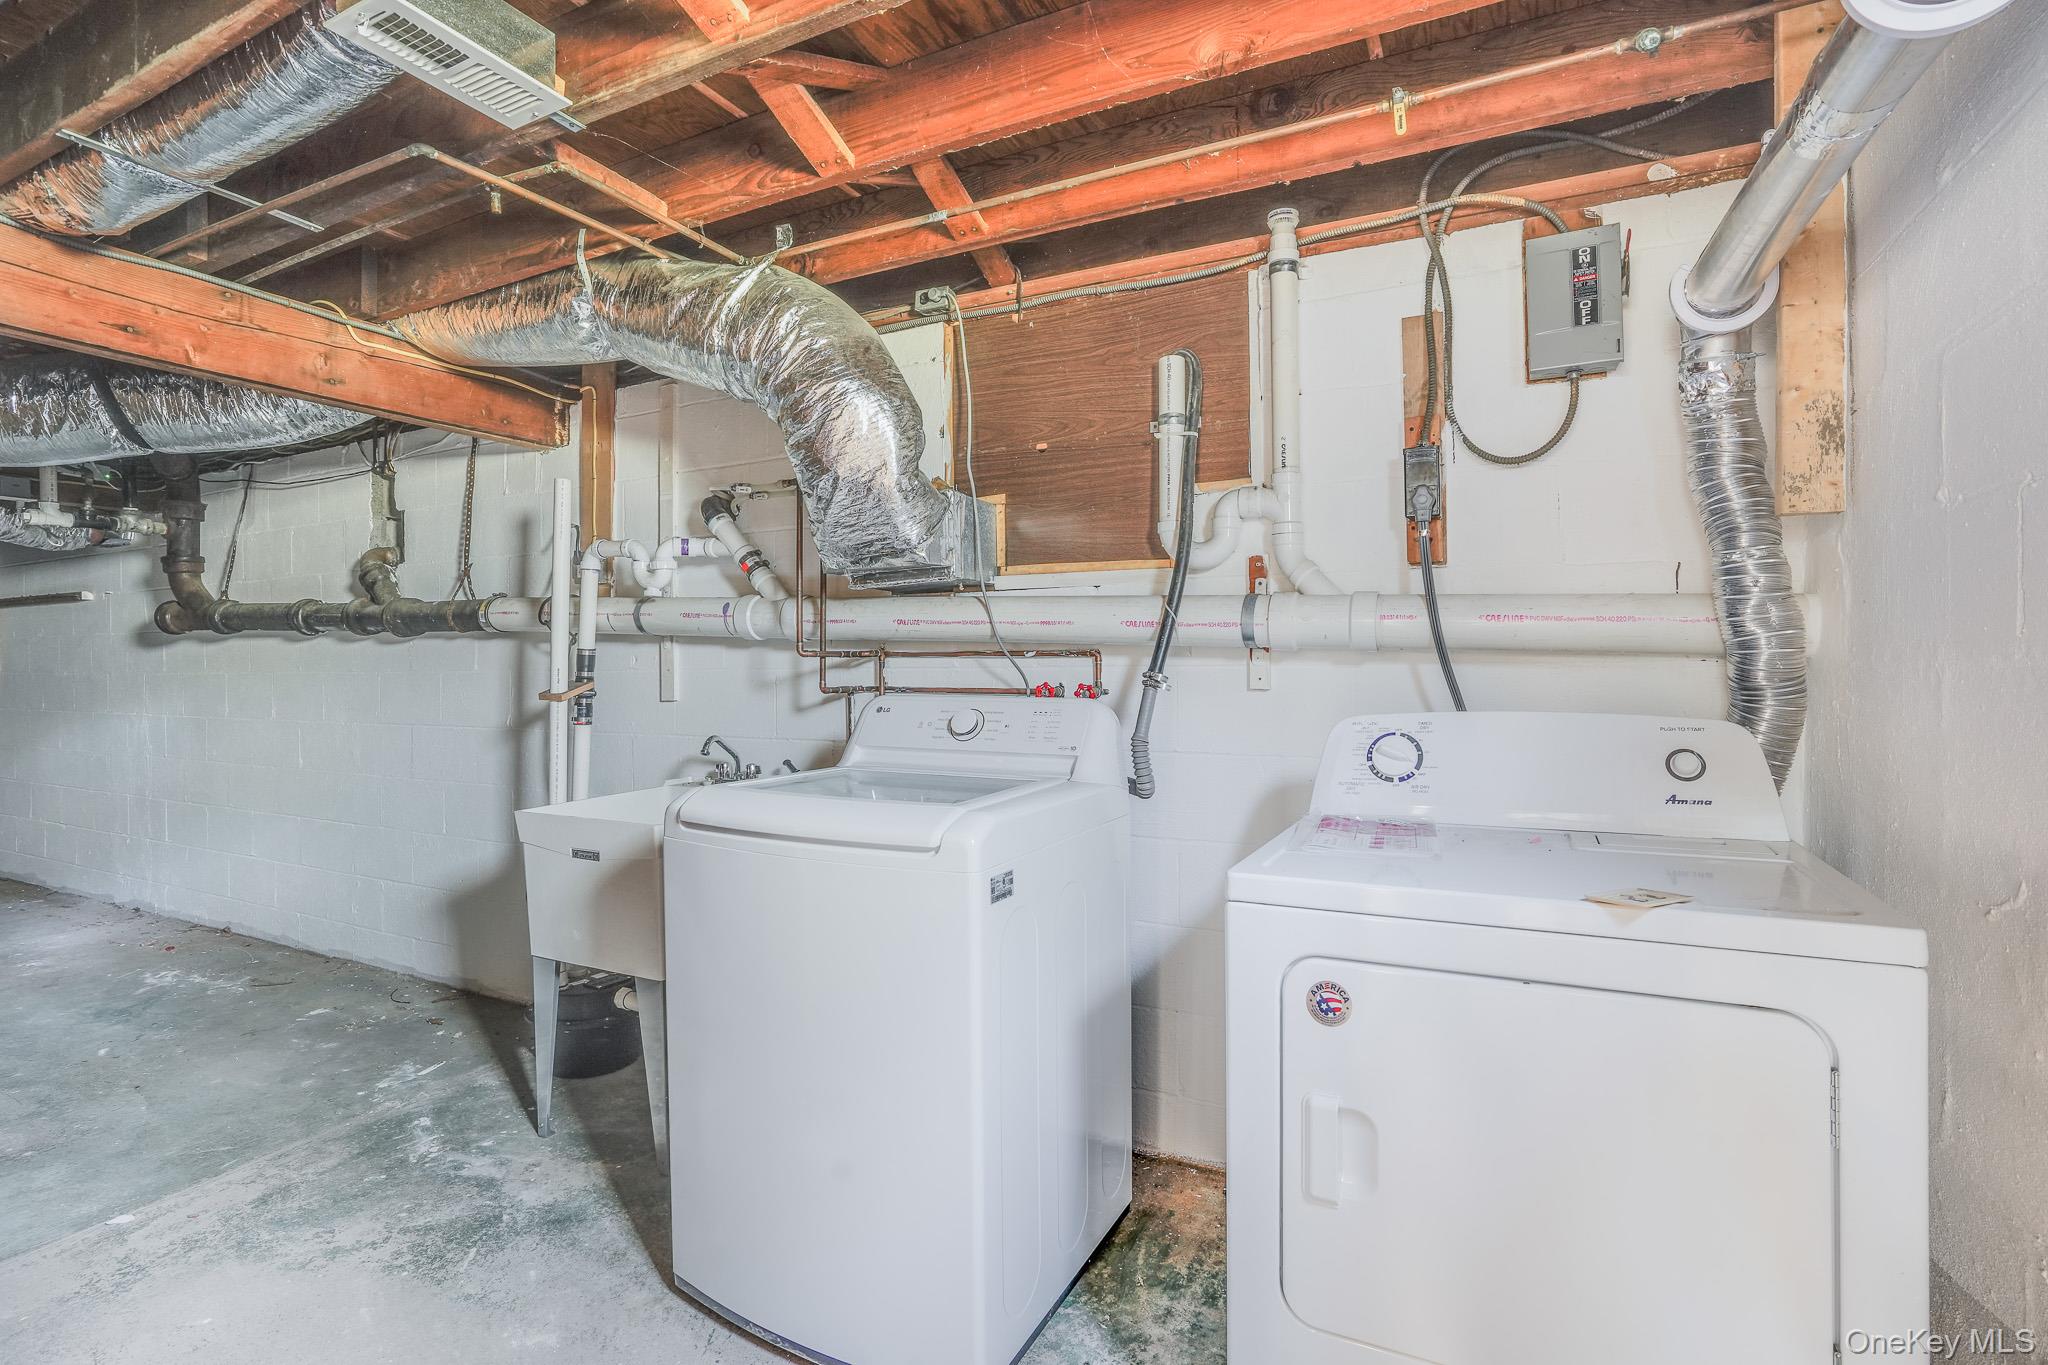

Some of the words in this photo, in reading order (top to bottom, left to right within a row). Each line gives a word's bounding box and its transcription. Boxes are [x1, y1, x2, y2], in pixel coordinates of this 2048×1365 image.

[1578, 247, 1591, 264] ON
[1579, 300, 1592, 326] OFF
[1665, 794, 1713, 806] Amana
[1310, 982, 1350, 1004] AMERICA
